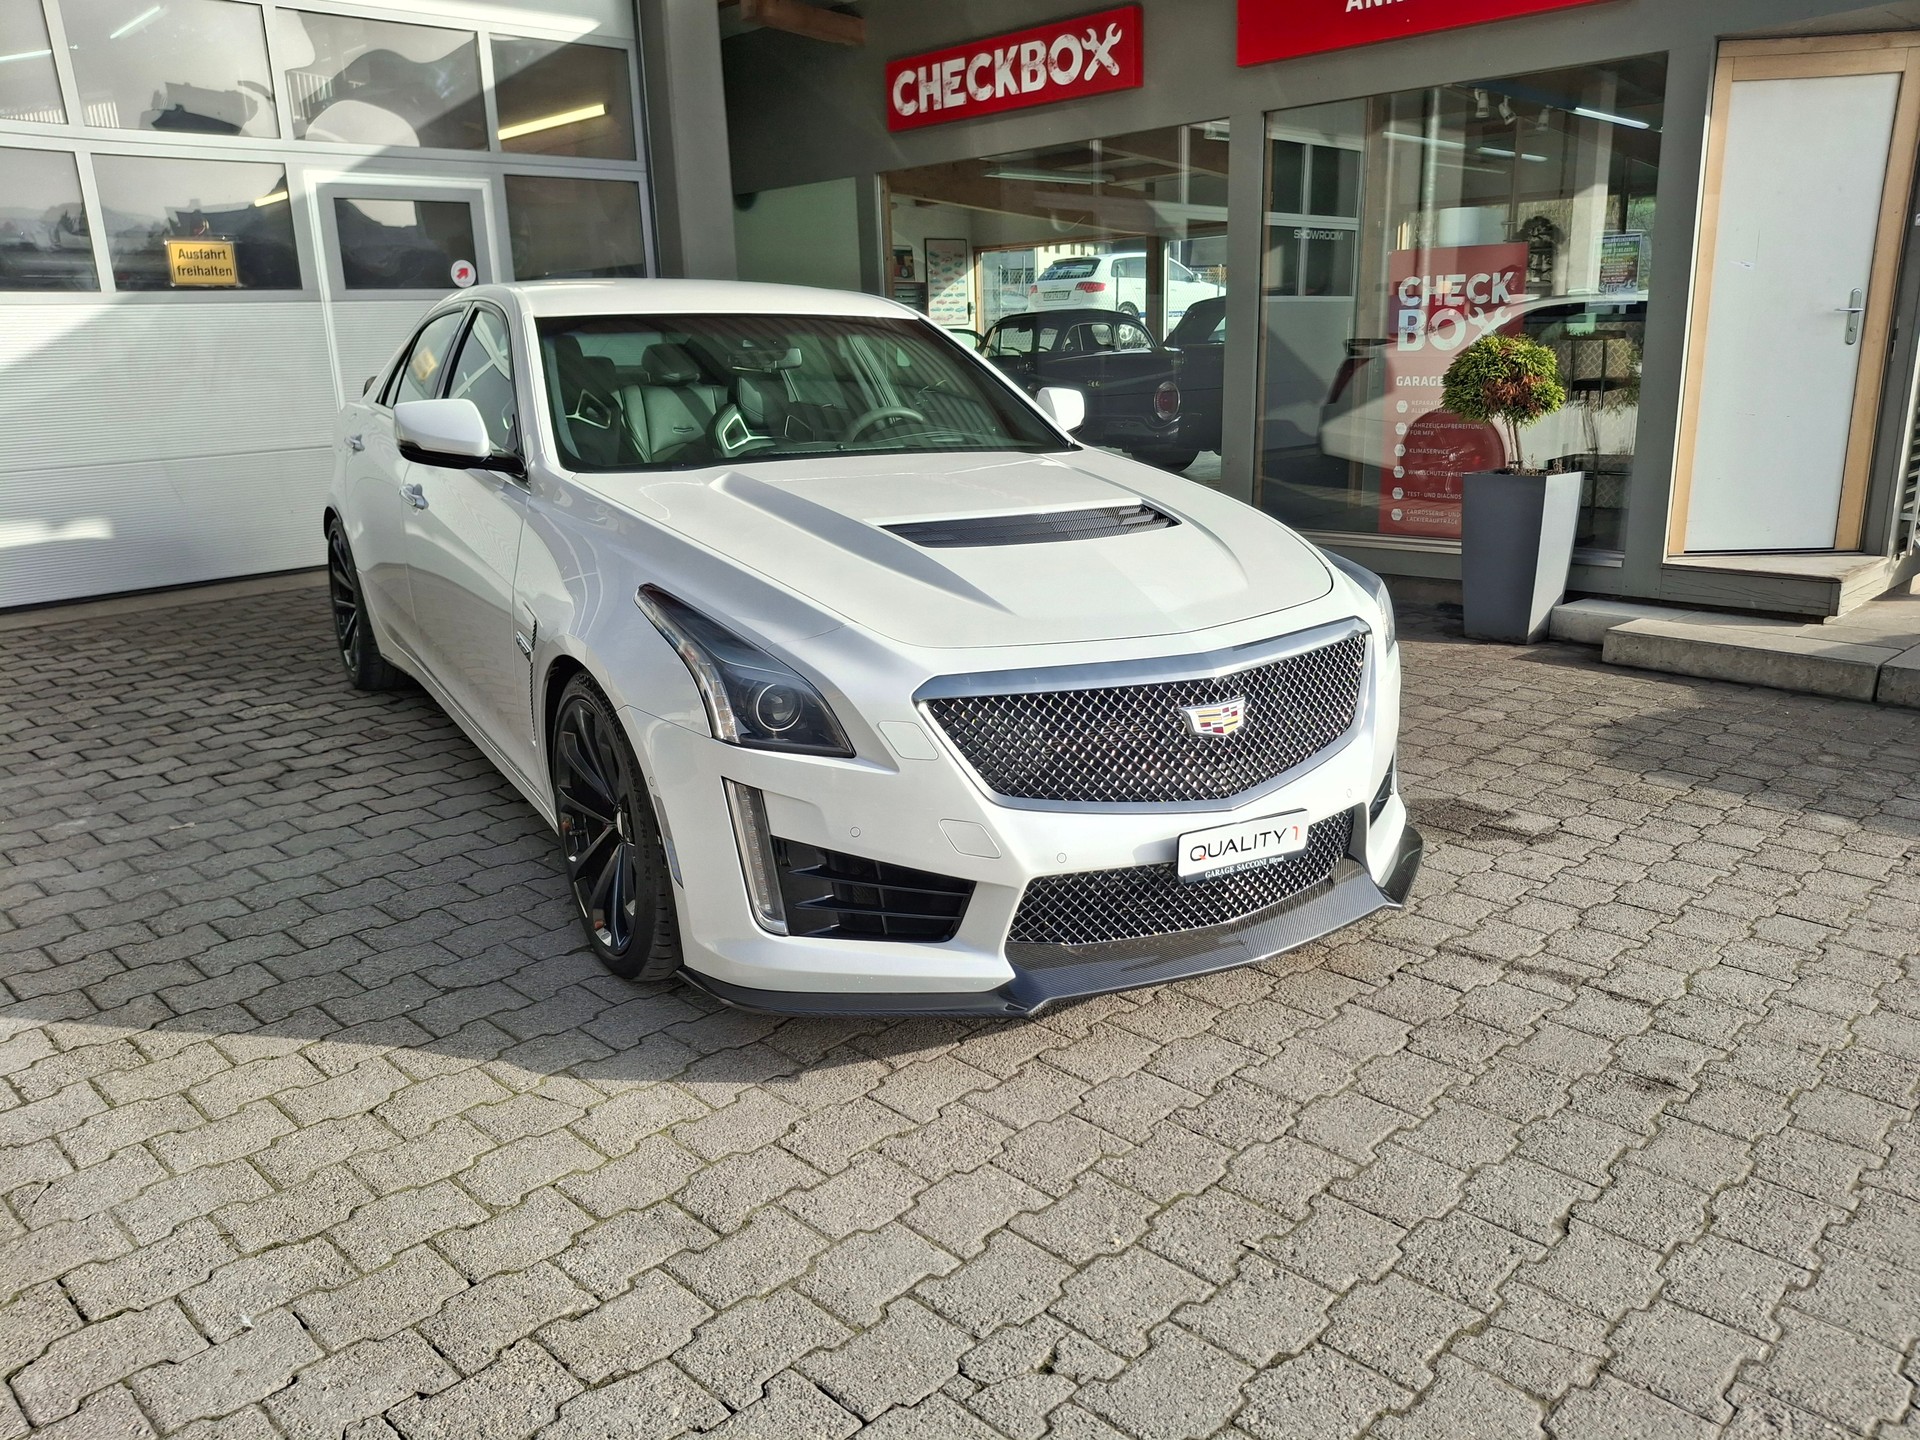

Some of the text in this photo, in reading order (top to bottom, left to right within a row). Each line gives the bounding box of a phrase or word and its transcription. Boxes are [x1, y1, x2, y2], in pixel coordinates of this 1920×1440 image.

[892, 22, 1123, 120] CHECKBOX
[1293, 229, 1343, 241] SHOWROOM
[178, 248, 227, 260] Ausfahrt
[176, 265, 233, 276] freihalten
[1398, 271, 1515, 307] CHECK
[1189, 826, 1298, 861] QUALITY 1
[1205, 865, 1235, 878] GARAGE
[1236, 859, 1267, 872] SACCONI
